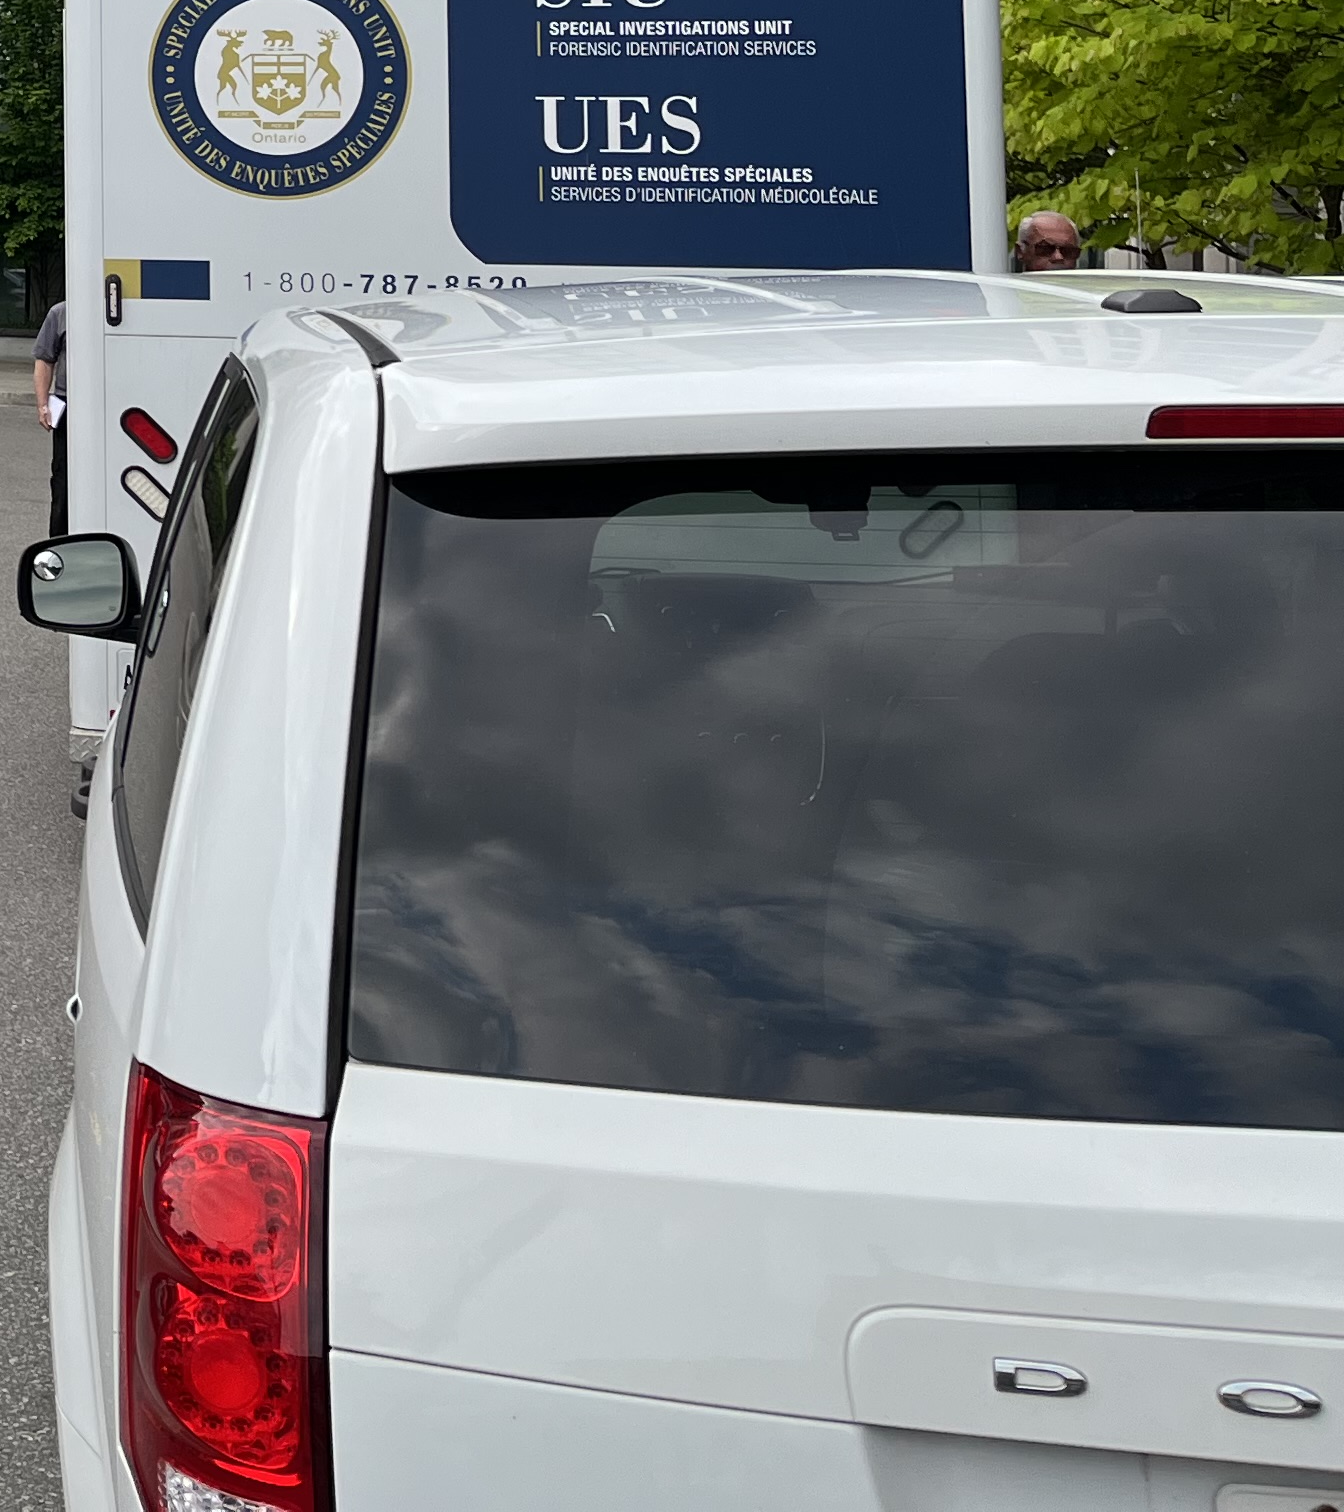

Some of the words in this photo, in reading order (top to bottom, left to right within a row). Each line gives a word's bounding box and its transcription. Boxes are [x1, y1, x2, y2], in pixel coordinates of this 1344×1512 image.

[363, 13, 396, 59] UNIT
[549, 21, 615, 36] SPECIAL
[619, 20, 749, 36] INVESTIGATIONS
[754, 20, 792, 35] UNIT
[549, 42, 621, 57] FORENSIC
[626, 41, 739, 57] IDENTIFICATION
[744, 40, 817, 56] SERVICES
[535, 95, 701, 155] UES
[163, 91, 206, 144] UNITÉ
[194, 139, 230, 171] DES
[230, 161, 329, 191] ENQUÊTES
[329, 91, 397, 172] SPÉCIALES
[252, 132, 306, 143] Ontario
[551, 164, 597, 181] UNITÉ
[602, 167, 633, 182] DES
[638, 164, 720, 183] ENQUÊTES
[724, 165, 813, 183] SPÉCIALES
[551, 187, 621, 202] SERVICES
[761, 185, 879, 205] MÉDICOLÉGALE
